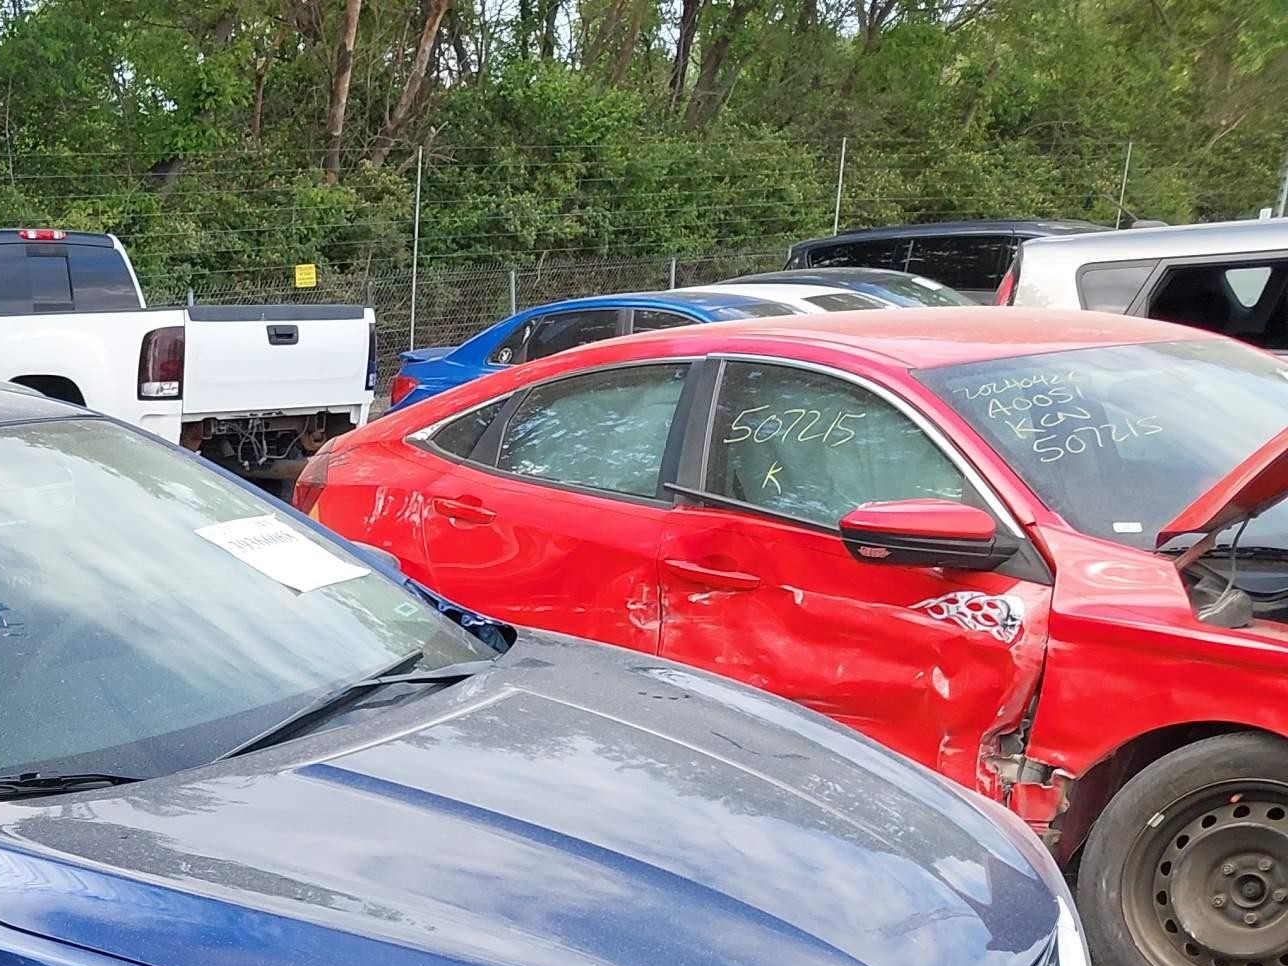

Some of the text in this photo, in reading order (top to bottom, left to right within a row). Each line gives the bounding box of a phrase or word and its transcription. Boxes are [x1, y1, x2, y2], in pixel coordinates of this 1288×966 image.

[723, 404, 866, 447] 507215
[1033, 415, 1163, 463] 507215
[762, 460, 783, 494] K
